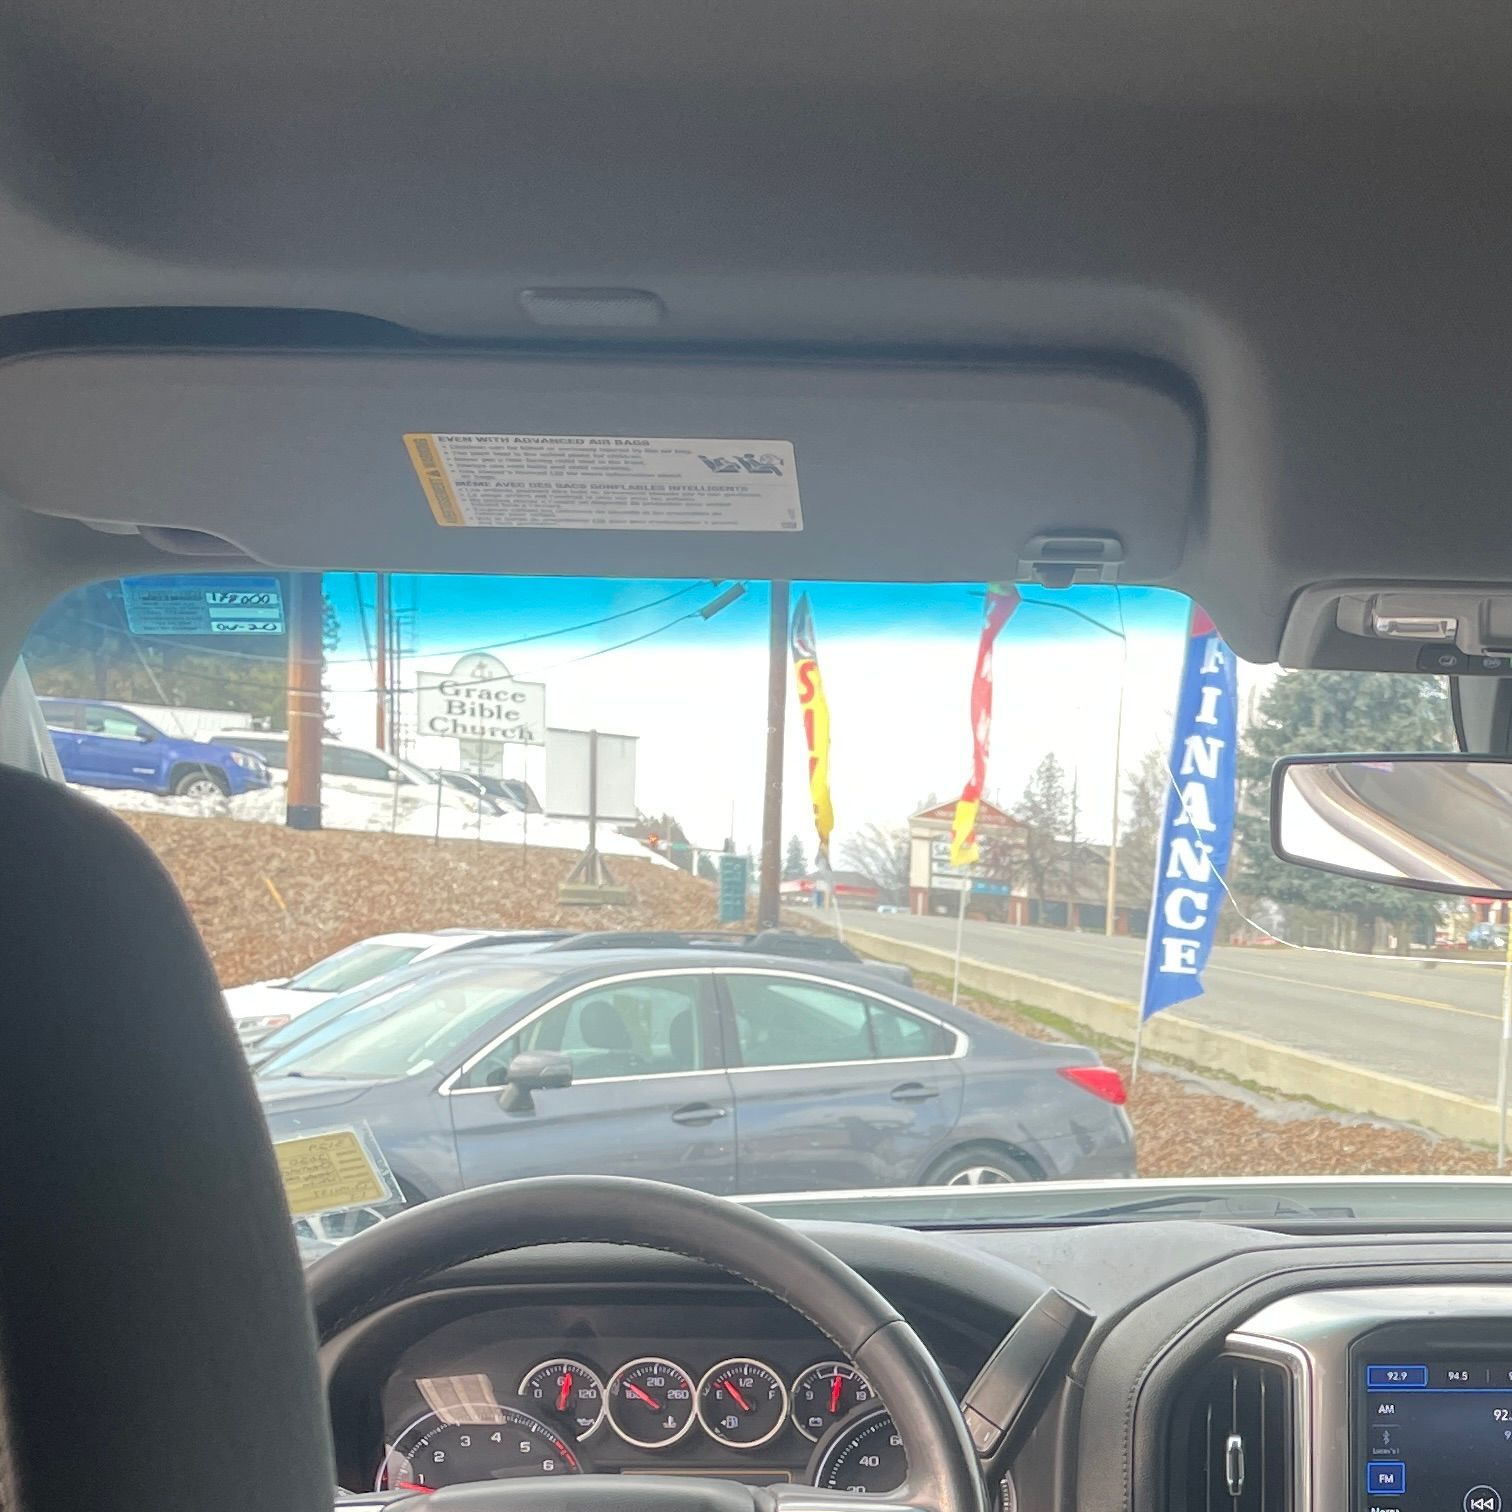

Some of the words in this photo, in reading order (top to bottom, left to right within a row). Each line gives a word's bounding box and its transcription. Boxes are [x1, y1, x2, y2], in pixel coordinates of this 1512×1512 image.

[438, 435, 472, 443] EVEN
[475, 435, 509, 443] WITH
[514, 437, 584, 445] ADVANCED
[588, 438, 610, 446] AIR
[439, 680, 527, 703] Grace
[446, 700, 520, 720] Bible
[428, 716, 534, 741] Church
[1159, 637, 1225, 975] FINANCE
[1387, 1371, 1408, 1381] 92.9
[1448, 1371, 1468, 1381] 94.5
[646, 1377, 665, 1387] 210
[739, 1378, 754, 1388] 1/2
[534, 1389, 543, 1399] 0
[578, 1389, 597, 1399] 120
[667, 1389, 689, 1399] 260
[1378, 1404, 1395, 1414] AM
[460, 1435, 471, 1447] 3
[490, 1432, 502, 1443] 4
[520, 1441, 531, 1453] 5
[434, 1450, 445, 1462] 2
[859, 1455, 880, 1467] 40
[543, 1459, 554, 1471] 6
[1379, 1473, 1394, 1484] FM
